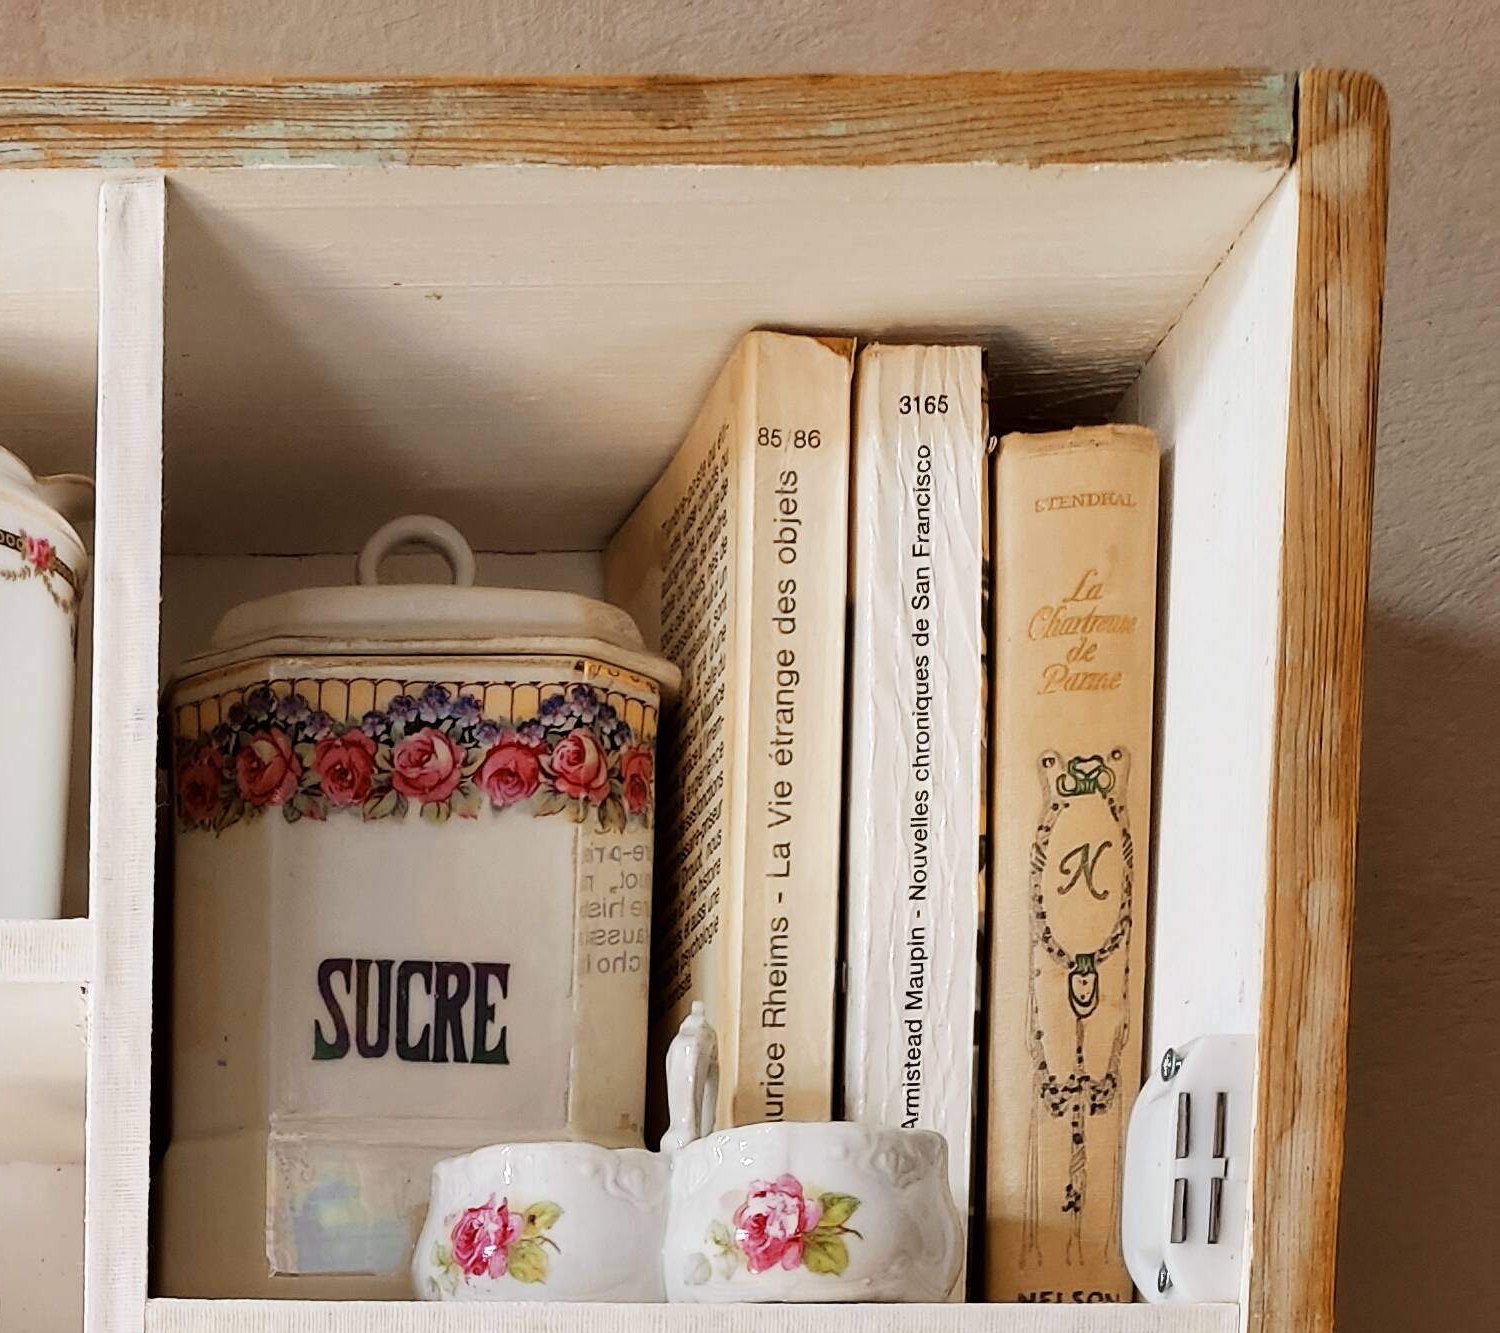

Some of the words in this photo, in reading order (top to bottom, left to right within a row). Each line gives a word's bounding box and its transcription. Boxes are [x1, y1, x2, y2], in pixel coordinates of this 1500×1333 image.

[900, 395, 948, 414] 3165
[774, 471, 801, 564] objets
[913, 445, 931, 557] Francisco
[1035, 492, 1137, 513] STENDHAL
[772, 580, 796, 634] des
[912, 567, 929, 609] San
[1062, 569, 1103, 603] La
[912, 619, 929, 646] de
[1066, 636, 1097, 663] de
[769, 650, 799, 765] étrange
[1037, 663, 1122, 695] Parme
[912, 656, 932, 781] chroniques
[768, 781, 792, 827] Vie
[766, 843, 791, 878] La
[909, 791, 928, 900] Nouvelles
[762, 918, 788, 1027] Rheims
[905, 928, 928, 1009] Maupin
[312, 958, 510, 1064] SUCRE
[760, 1043, 785, 1122] urice
[901, 1020, 922, 1128] Armistead
